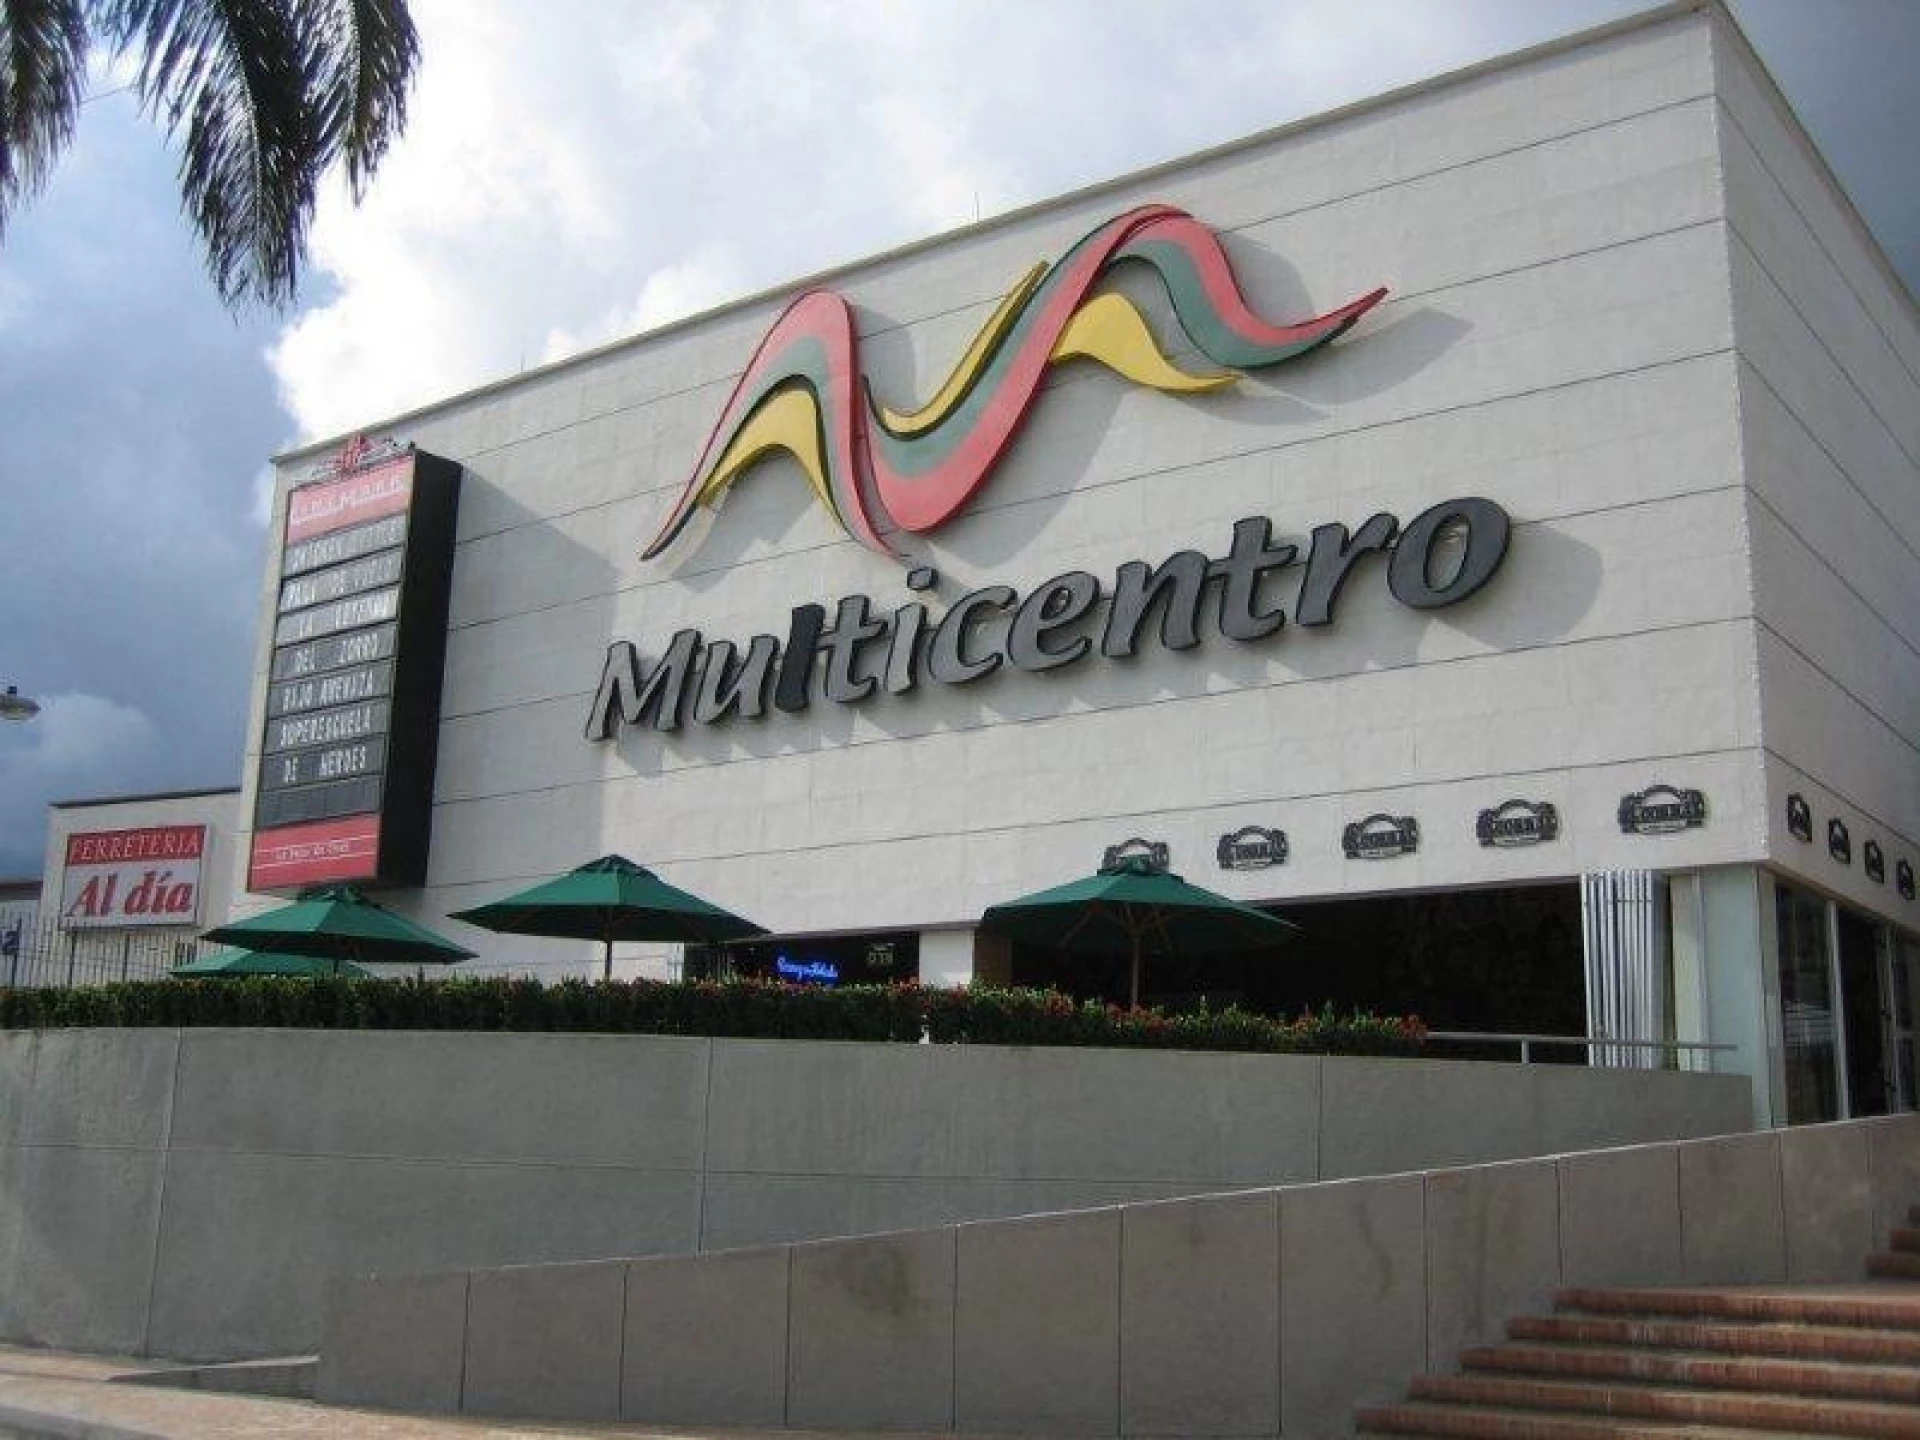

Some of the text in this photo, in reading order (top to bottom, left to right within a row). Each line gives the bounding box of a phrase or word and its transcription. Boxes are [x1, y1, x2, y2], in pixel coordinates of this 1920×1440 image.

[585, 495, 1512, 741] Multicentro
[70, 830, 199, 861] FERRETERIA
[64, 870, 193, 917] Al día
